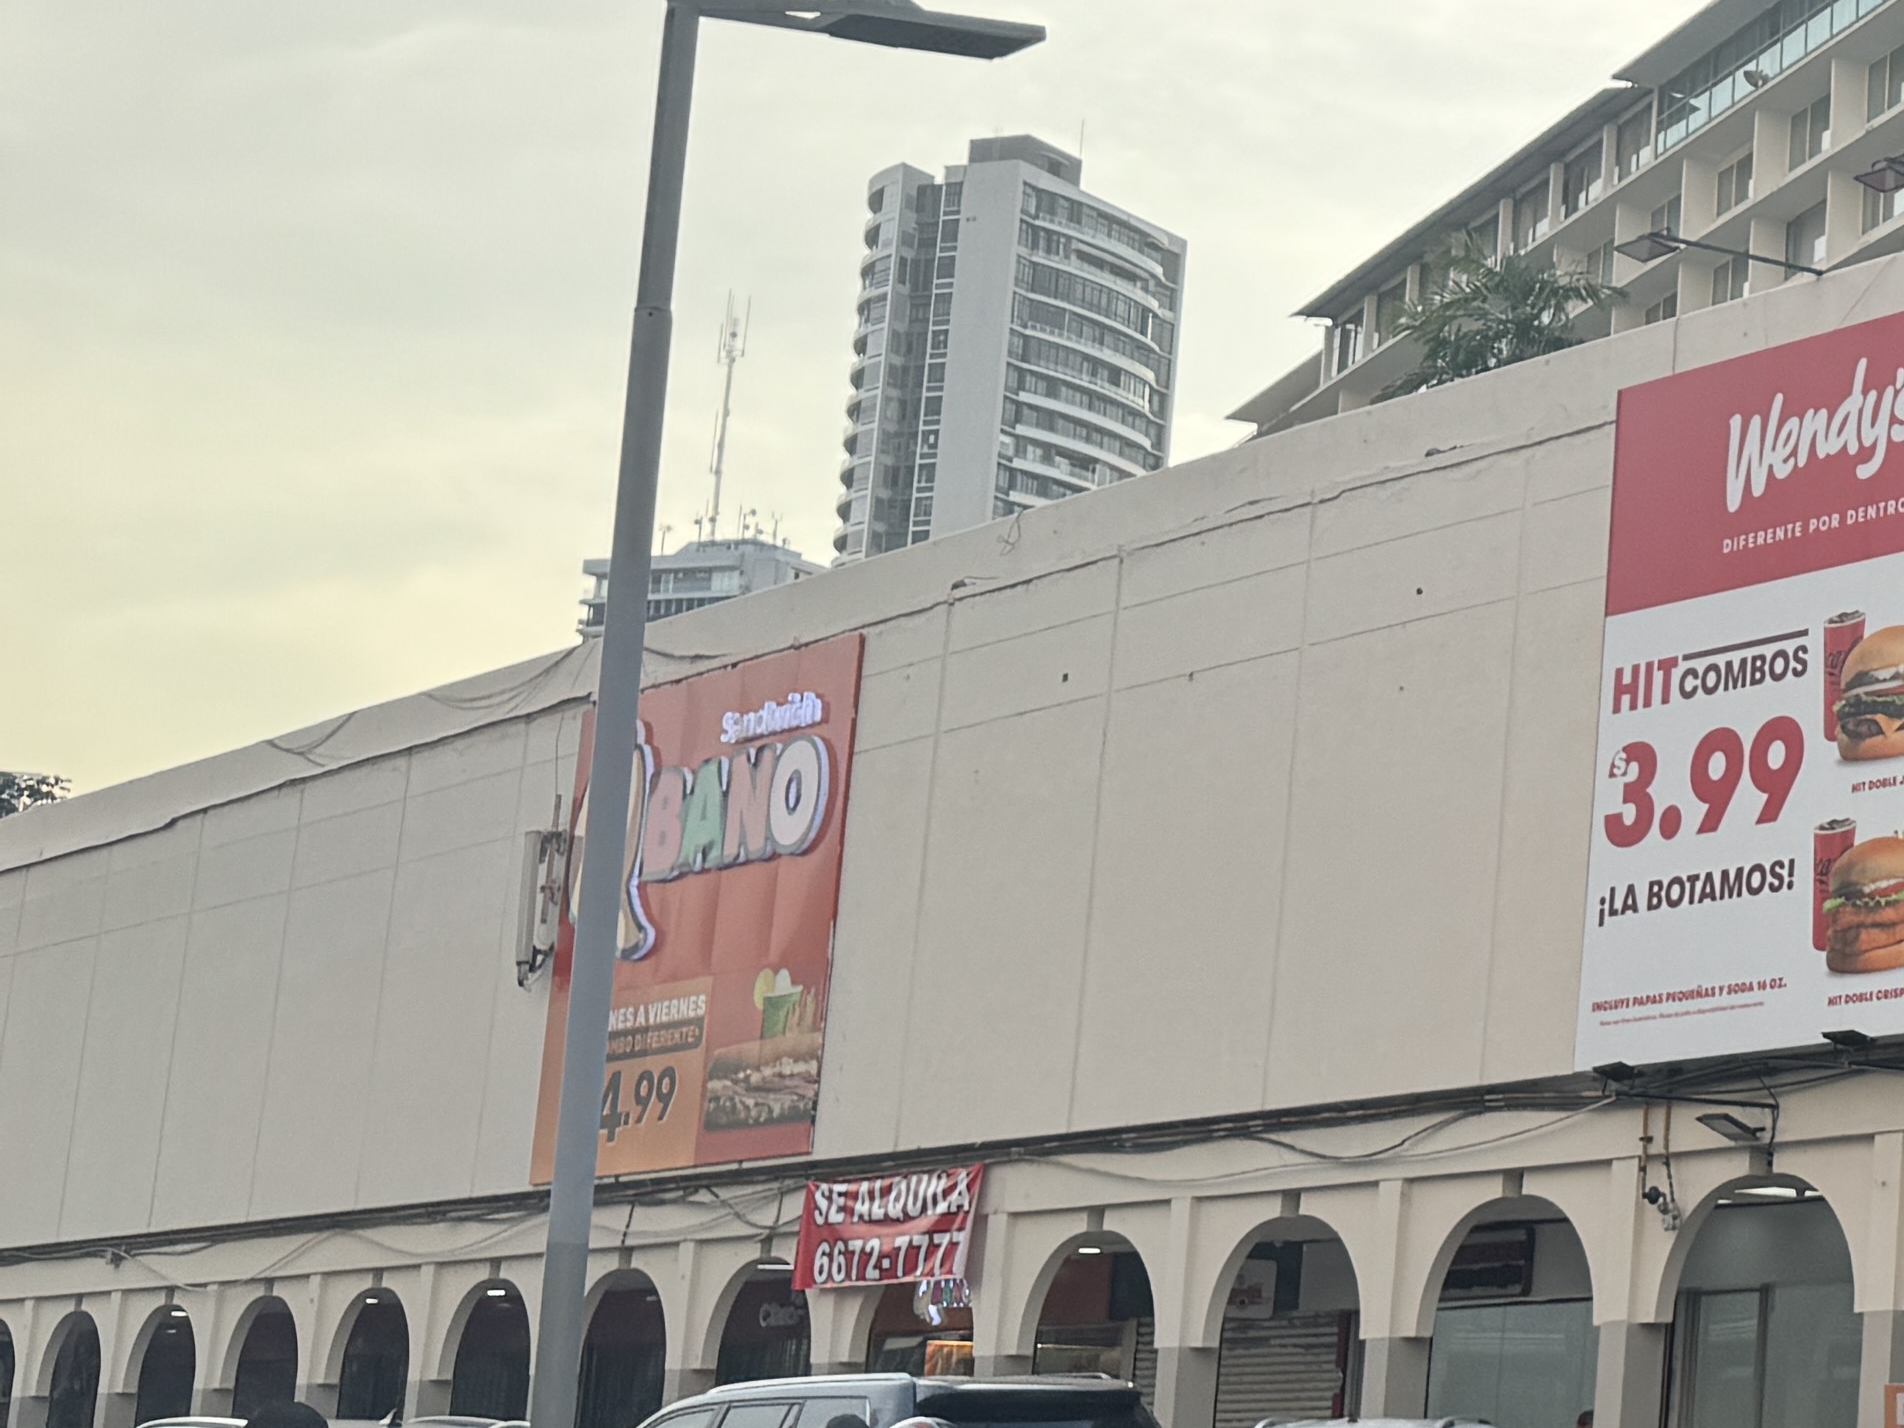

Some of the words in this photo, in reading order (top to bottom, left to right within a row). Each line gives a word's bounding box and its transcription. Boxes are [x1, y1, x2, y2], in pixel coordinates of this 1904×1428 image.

[1722, 522, 1803, 554] DIFERENTE
[1809, 513, 1840, 534] POR
[1612, 656, 1679, 715] HIT
[1678, 644, 1809, 700] COMBOS
[1851, 781, 1866, 794] HIT
[1868, 776, 1897, 791] DOBLE
[1598, 883, 1639, 928] ¡LA
[1647, 858, 1795, 911] BOTAMOS!
[608, 1006, 635, 1031] NES
[635, 1004, 646, 1027] A
[648, 994, 706, 1023] VIERNES
[1632, 993, 1664, 1007] PAPAS
[1727, 981, 1754, 995] SODA
[1827, 995, 1842, 1007] HIT
[1844, 990, 1874, 1005] DOBLE
[813, 1183, 848, 1225] SE
[853, 1168, 971, 1222] ALQUILA
[813, 1230, 967, 1284] 6672-7777
